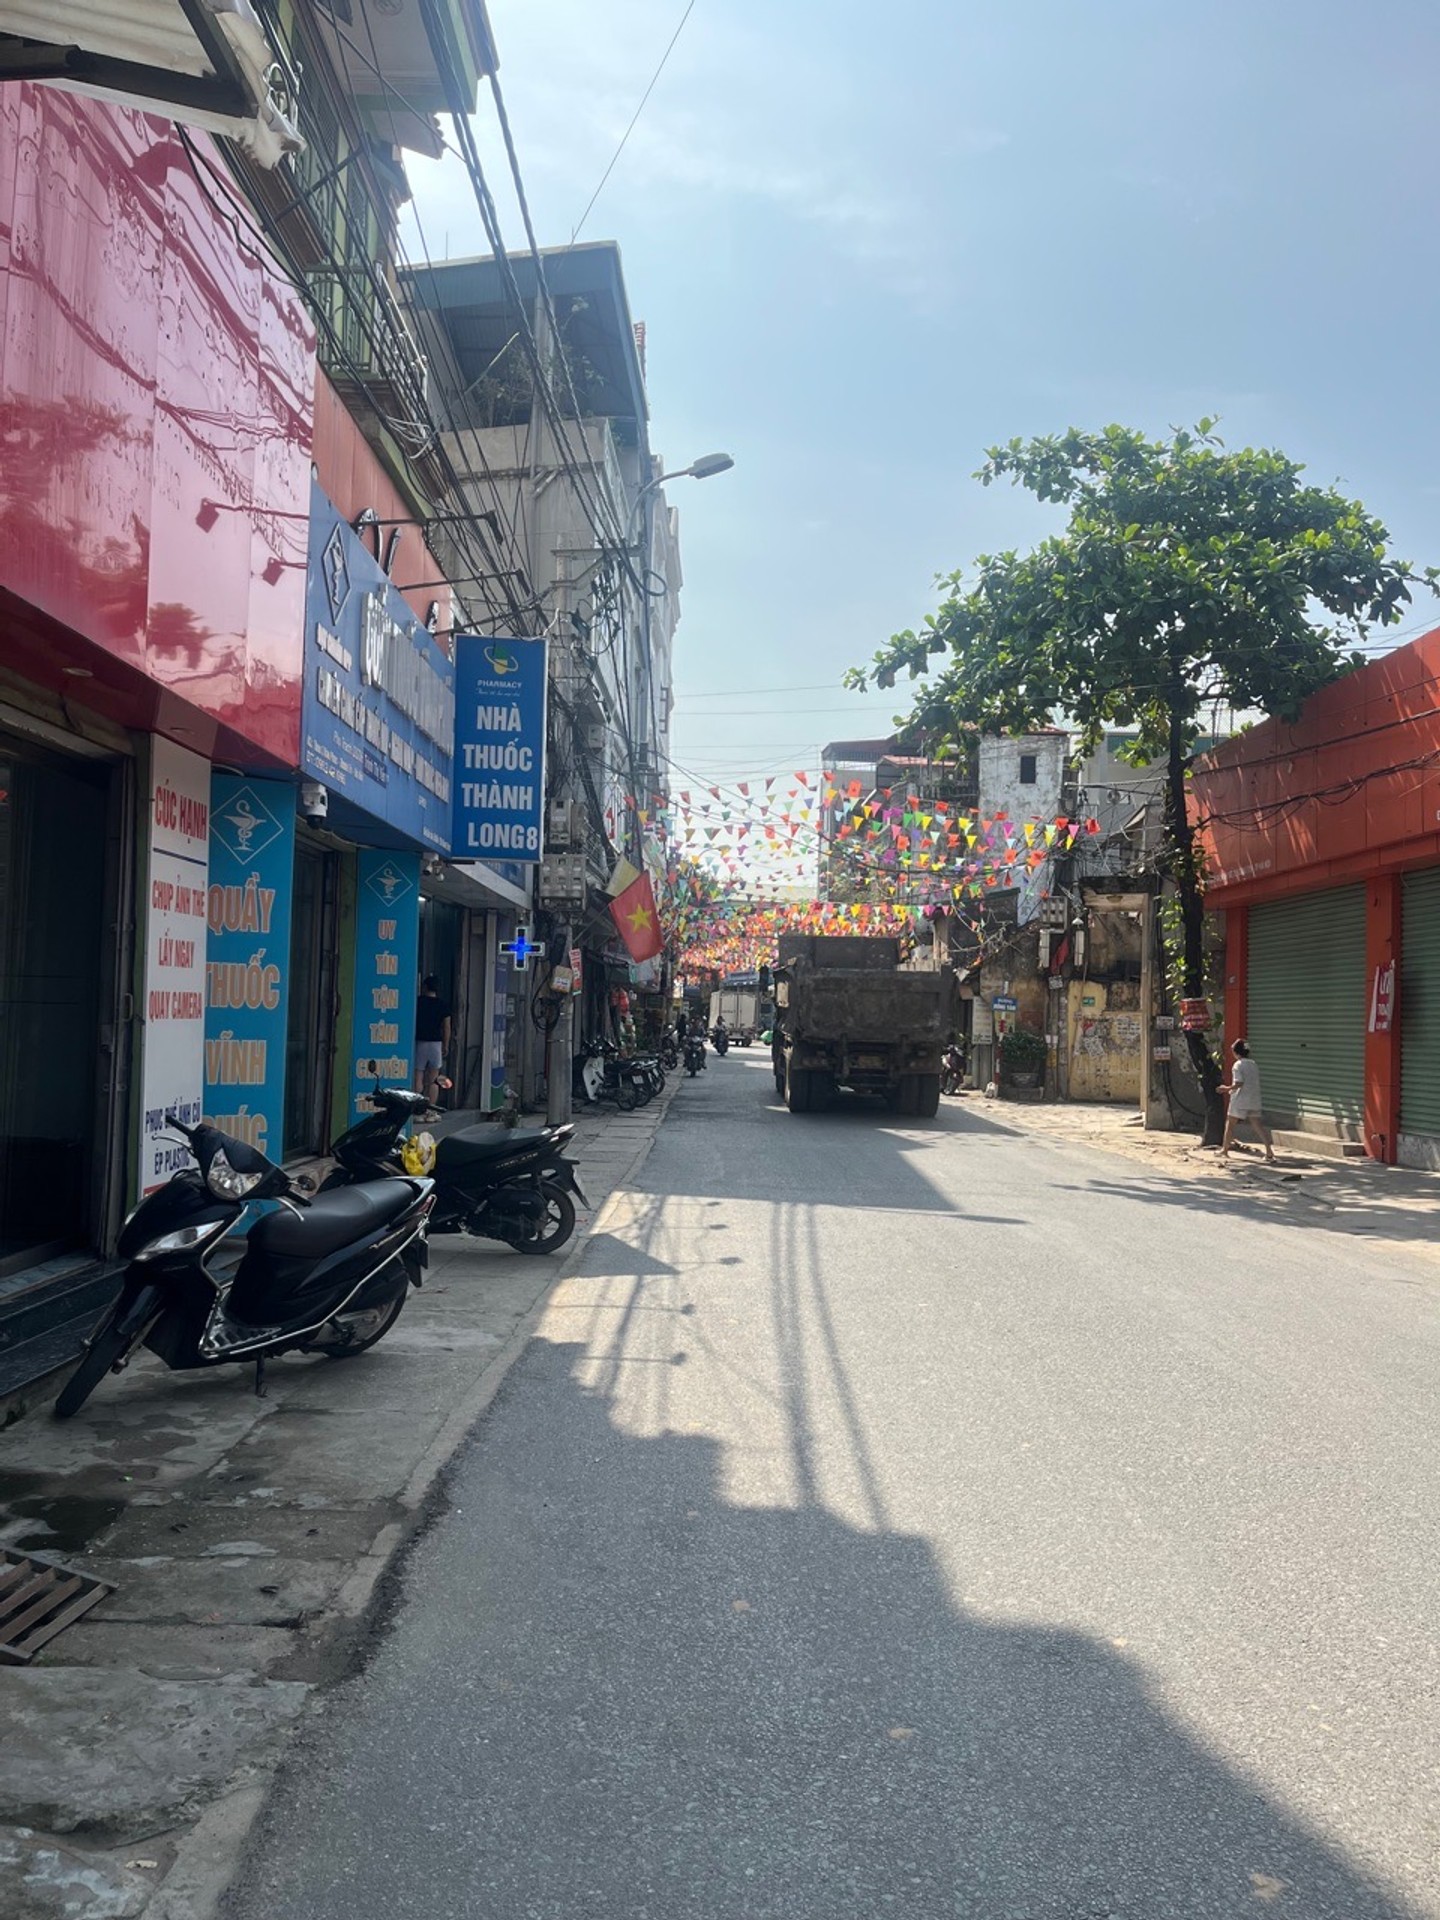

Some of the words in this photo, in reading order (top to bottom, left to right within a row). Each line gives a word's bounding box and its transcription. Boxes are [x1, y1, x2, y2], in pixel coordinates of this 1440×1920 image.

[477, 679, 522, 689] PHARMACY
[477, 702, 522, 732] NHÀ
[462, 738, 533, 772] THUỐC
[461, 779, 533, 811] THÀNH
[155, 778, 177, 831] CÚC
[179, 794, 207, 844] HẠNH
[468, 821, 539, 851] LONG8
[152, 879, 174, 917] CHỤP
[174, 873, 191, 915] ẢNH
[207, 871, 276, 936] QUẦY
[378, 919, 398, 940] UY
[158, 927, 173, 967] LẤY
[174, 939, 195, 969] NGAY
[375, 950, 398, 975] TÍN
[149, 990, 170, 1023] QUAY
[171, 991, 202, 1020] CAMERA
[372, 984, 399, 1014] TẬN
[205, 1030, 267, 1086] VĨNH
[145, 1108, 164, 1136] PHỤC
[154, 1147, 164, 1175] ÉP
